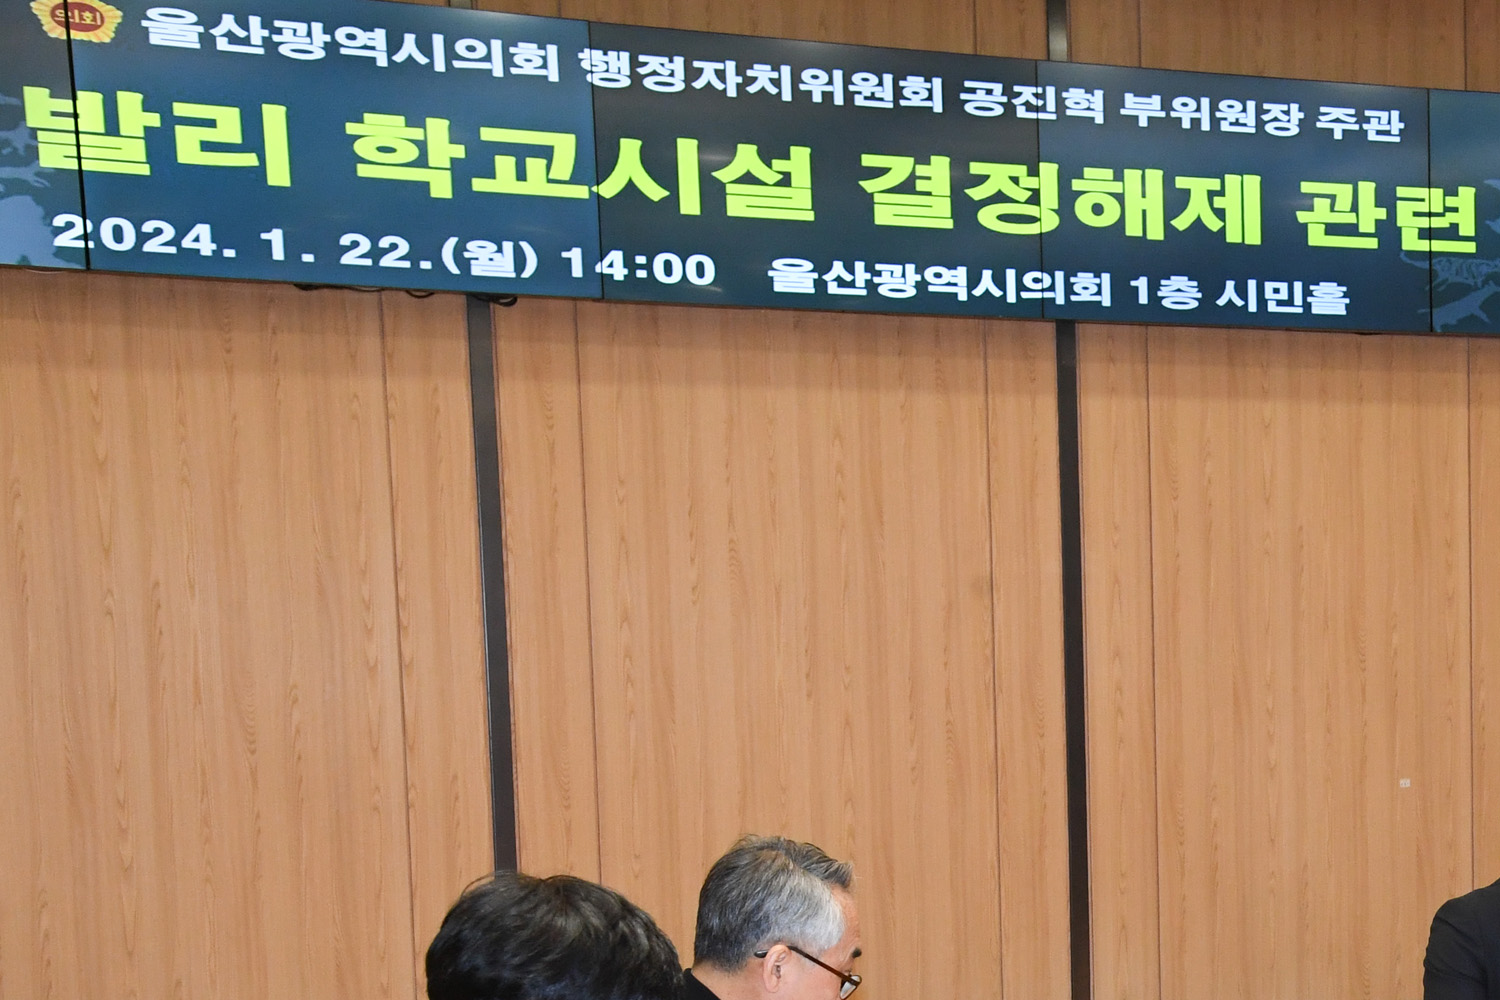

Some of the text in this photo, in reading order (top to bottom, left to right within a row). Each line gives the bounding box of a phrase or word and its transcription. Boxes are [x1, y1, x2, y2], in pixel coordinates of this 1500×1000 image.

[54, 9, 101, 26] 의회
[140, 6, 1404, 142] 울산광역시의회 행정자치위원회 공진혁 부위원장 주관
[23, 86, 291, 187] 발리
[345, 113, 814, 221] 학교시설
[859, 154, 1261, 245] 결정해제
[1297, 181, 1476, 253] 관련
[53, 214, 1349, 314] 2024. 1. 22.(월) 14:00 울산광역시의회 1층 시민홀
